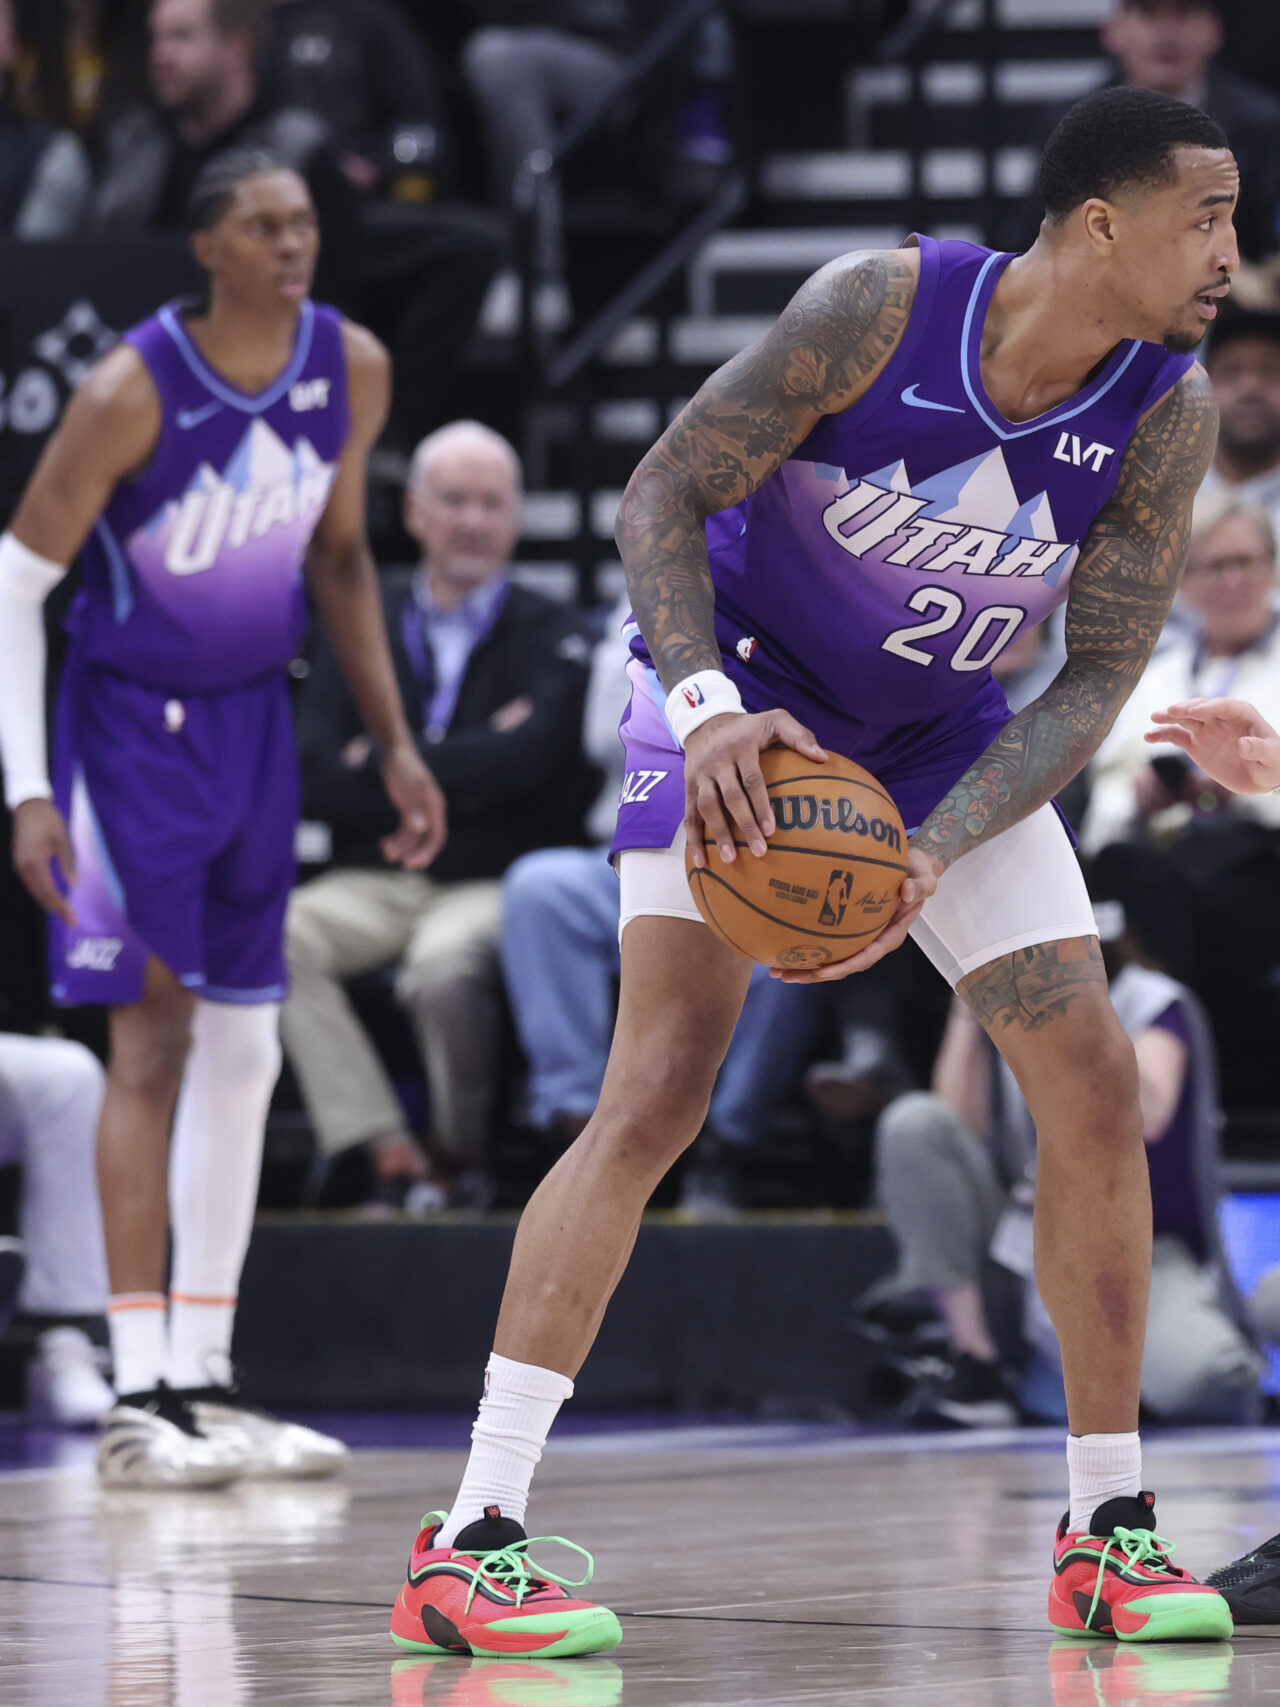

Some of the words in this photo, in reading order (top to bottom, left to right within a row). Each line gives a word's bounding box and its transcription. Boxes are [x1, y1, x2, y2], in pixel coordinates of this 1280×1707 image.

[1053, 431, 1115, 473] LVT
[164, 464, 335, 576] UTAH
[822, 478, 1077, 577] UTAH
[881, 584, 1027, 672] 20
[769, 794, 901, 855] Wilson
